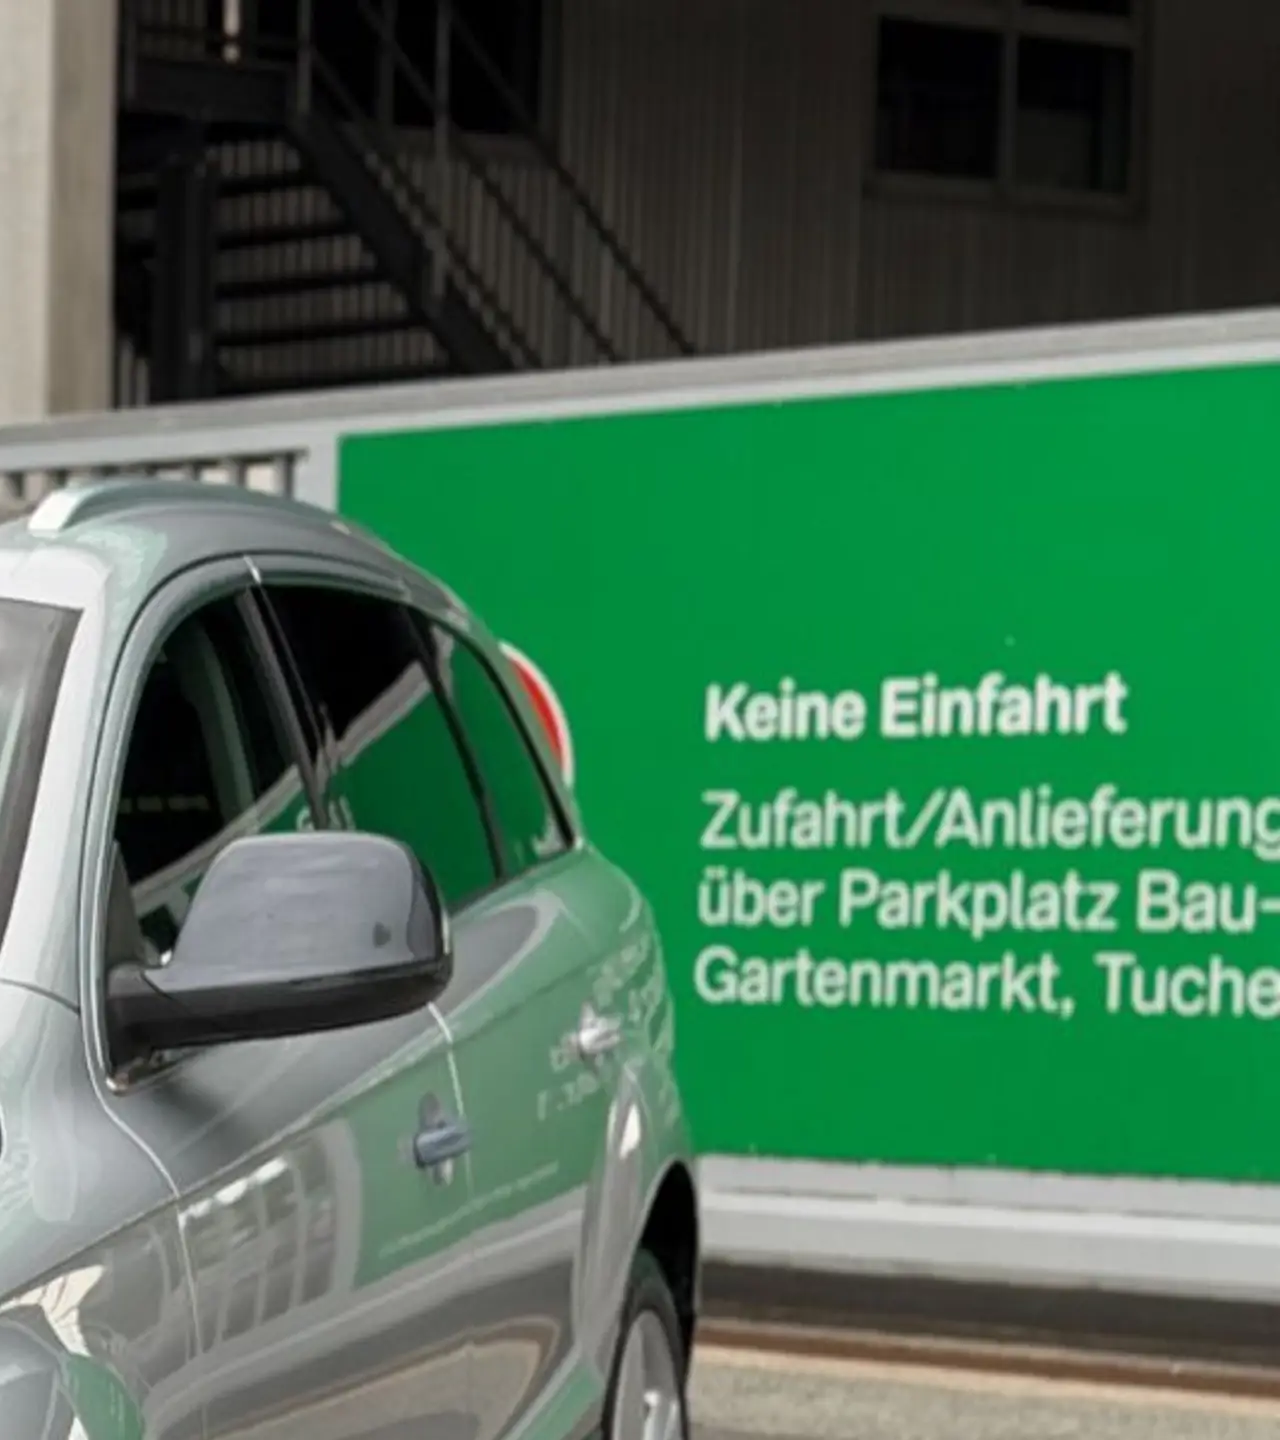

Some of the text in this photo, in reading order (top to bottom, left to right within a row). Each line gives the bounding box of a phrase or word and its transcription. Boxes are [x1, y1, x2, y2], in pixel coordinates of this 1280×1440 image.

[705, 672, 1128, 741] Keine Einfahrt
[699, 785, 1280, 861] Zufahrt/Anlieferung
[698, 866, 1280, 940] über Parkplatz Bau-
[694, 946, 1280, 1020] Gartenmarkt, Tuche
